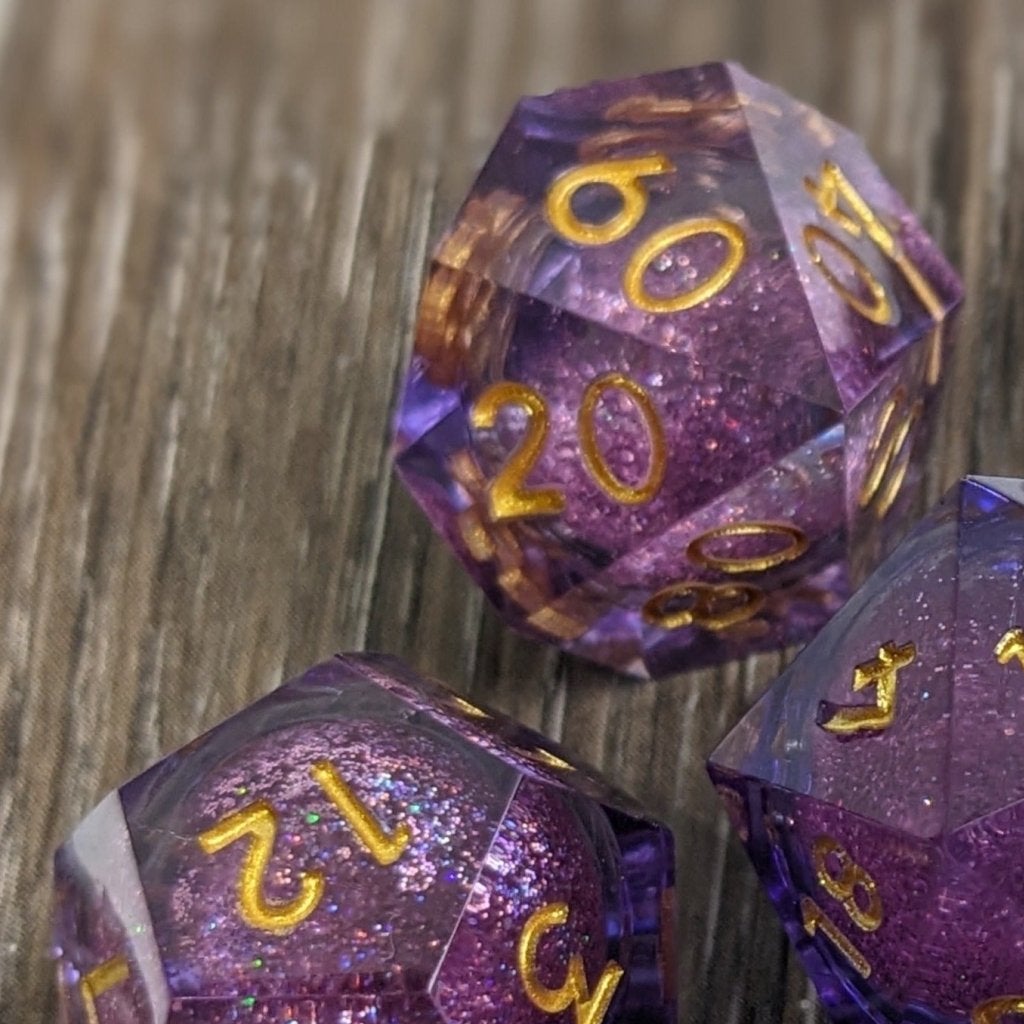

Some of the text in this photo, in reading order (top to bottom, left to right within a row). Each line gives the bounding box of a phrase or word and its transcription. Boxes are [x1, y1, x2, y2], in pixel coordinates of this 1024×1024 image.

[470, 373, 668, 521] 20
[199, 758, 411, 936] 12
[800, 834, 883, 980] 18
